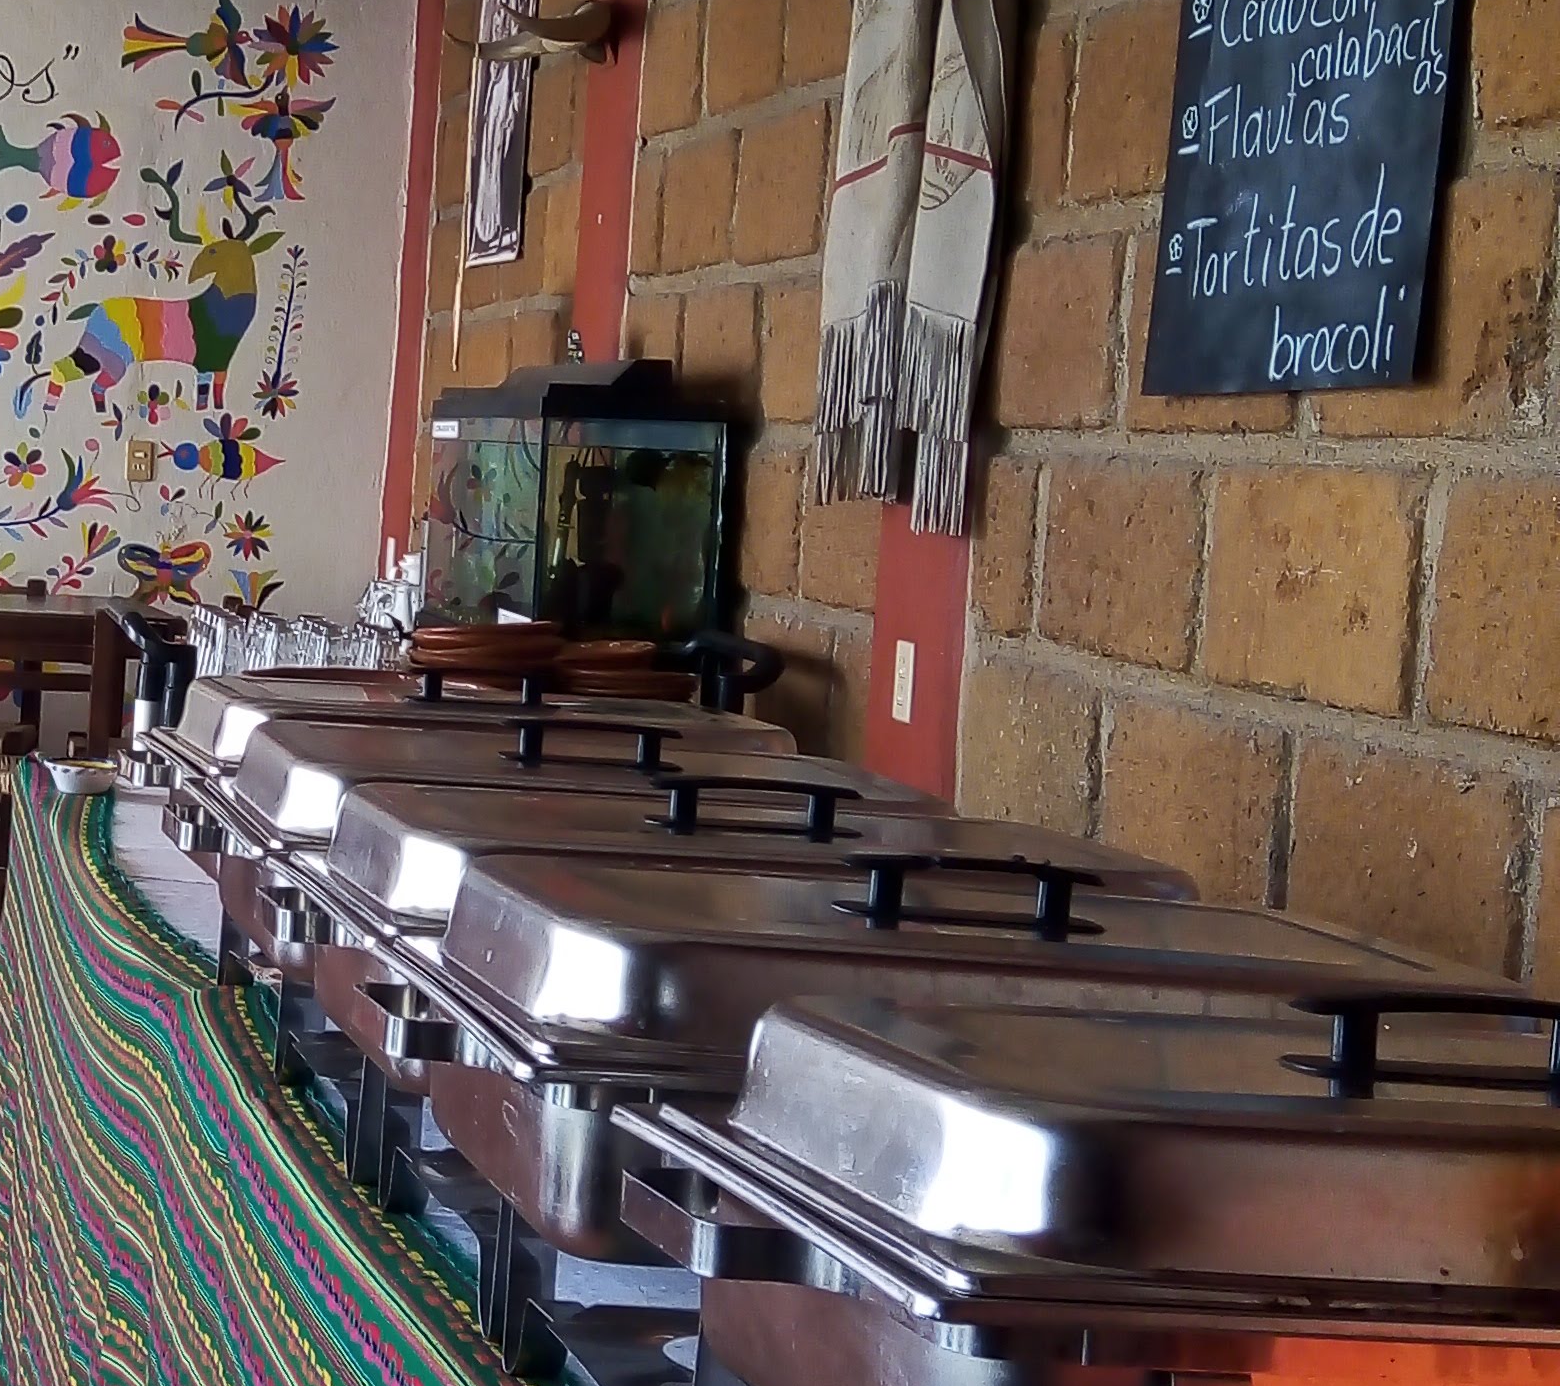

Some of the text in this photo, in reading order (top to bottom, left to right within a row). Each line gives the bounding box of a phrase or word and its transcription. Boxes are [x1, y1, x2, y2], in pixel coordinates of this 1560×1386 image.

[1204, 62, 1352, 165] Flautas
[1186, 162, 1403, 300] Tortitas de
